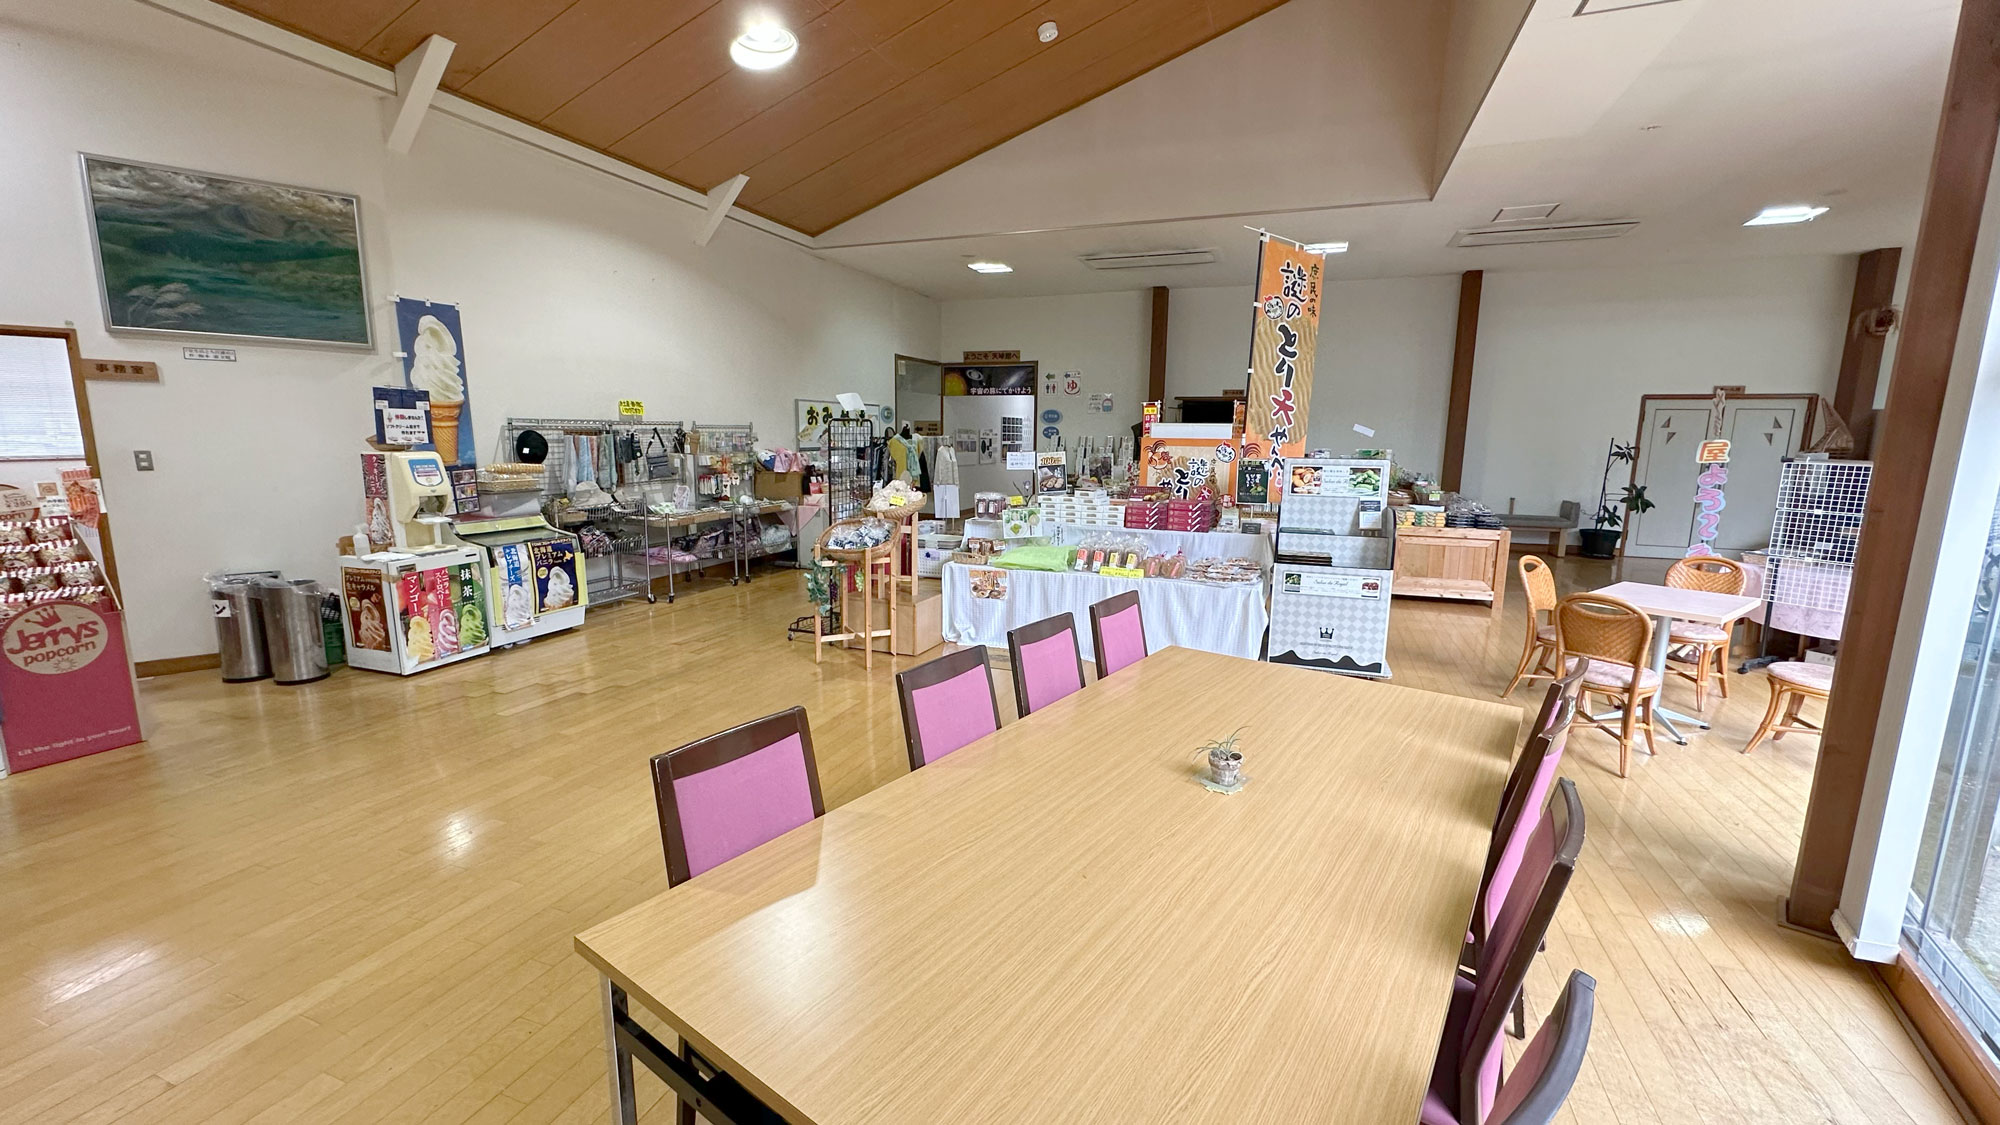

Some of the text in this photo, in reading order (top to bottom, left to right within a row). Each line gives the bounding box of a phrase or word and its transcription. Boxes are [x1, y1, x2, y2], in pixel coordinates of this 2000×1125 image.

[95, 363, 144, 375] 事務室
[970, 386, 1032, 395] 宇宙の旅にでかけよう
[1067, 379, 1078, 392] ゆ
[407, 574, 420, 613] マンゴー
[435, 572, 445, 607] ストロベリー
[460, 568, 474, 597] 抹茶
[23, 640, 97, 667] popcorn
